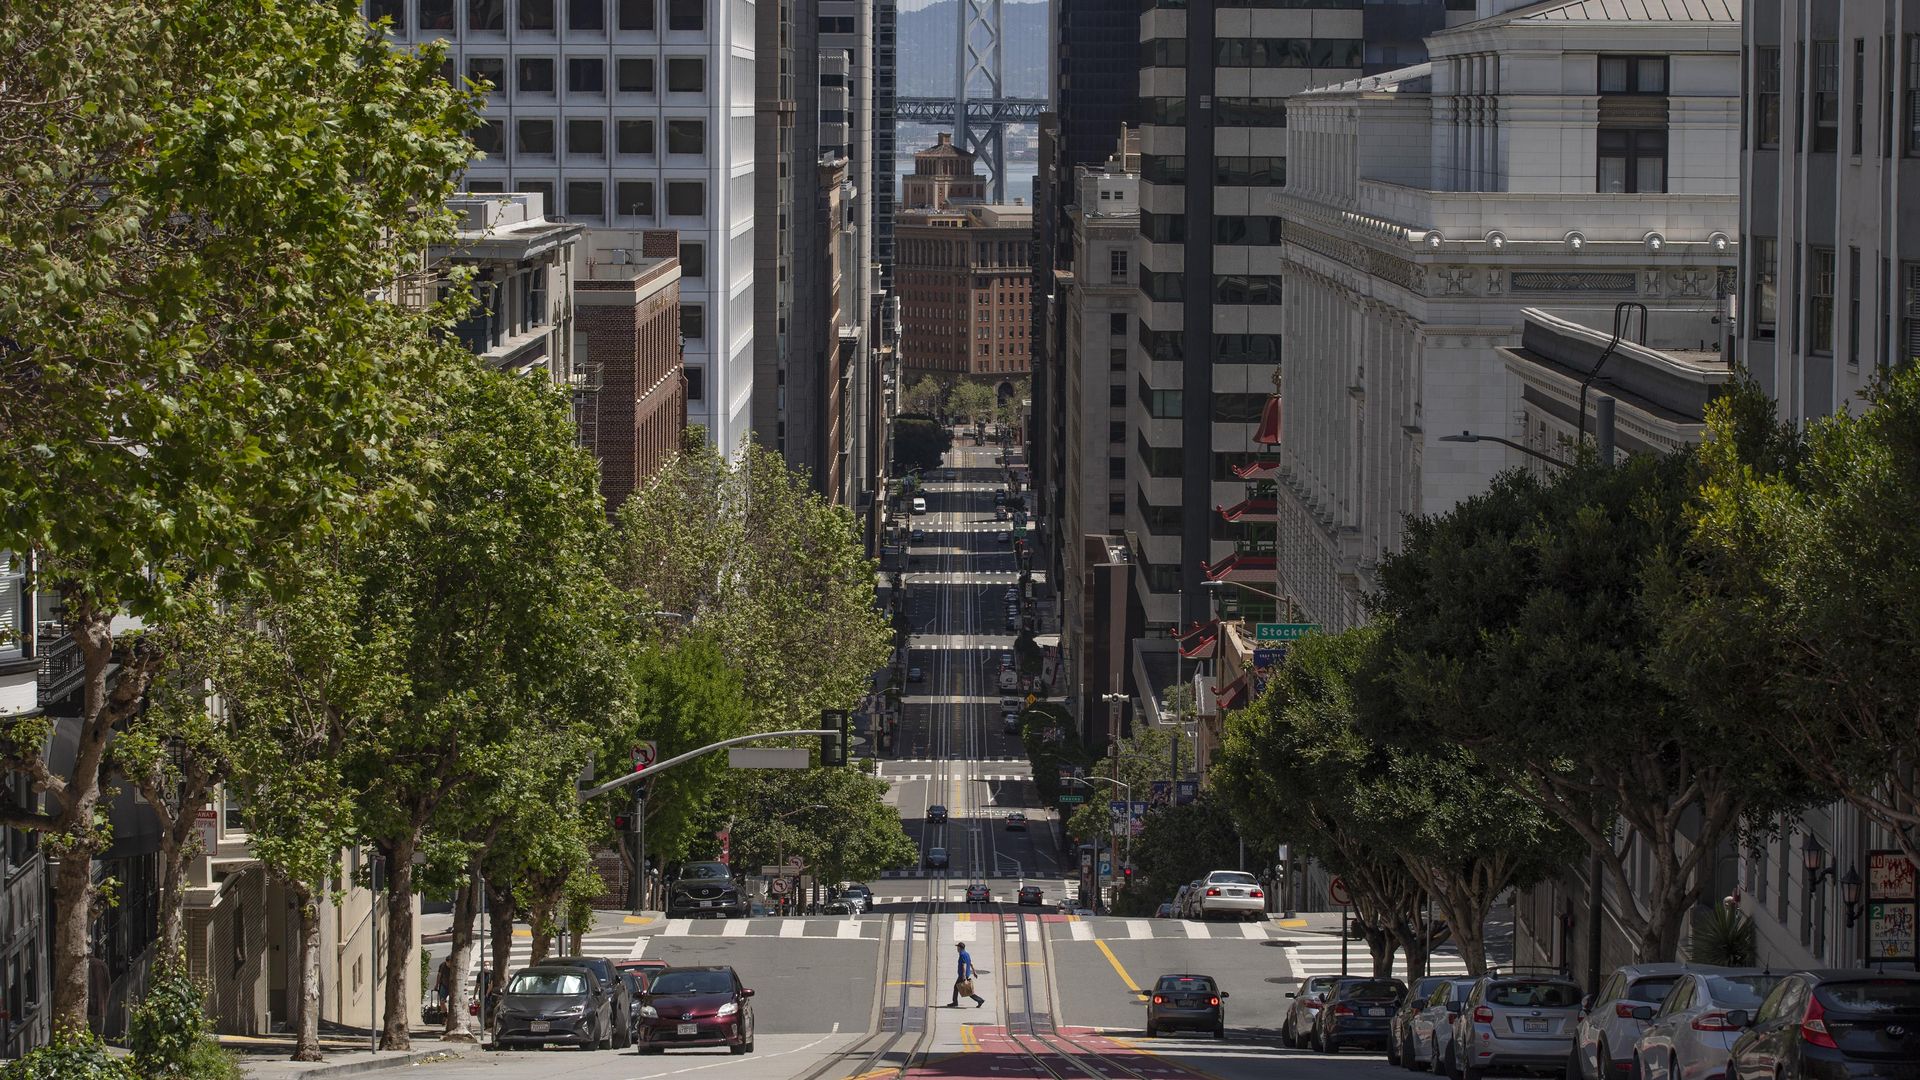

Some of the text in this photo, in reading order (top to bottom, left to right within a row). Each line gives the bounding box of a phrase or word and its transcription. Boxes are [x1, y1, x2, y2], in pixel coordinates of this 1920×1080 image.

[1262, 627, 1309, 636] Stockt
[1872, 856, 1883, 867] NO
[1101, 863, 1110, 874] P
[1873, 870, 1879, 879] 7
[1873, 906, 1881, 918] 2
[1875, 921, 1880, 930] 8
